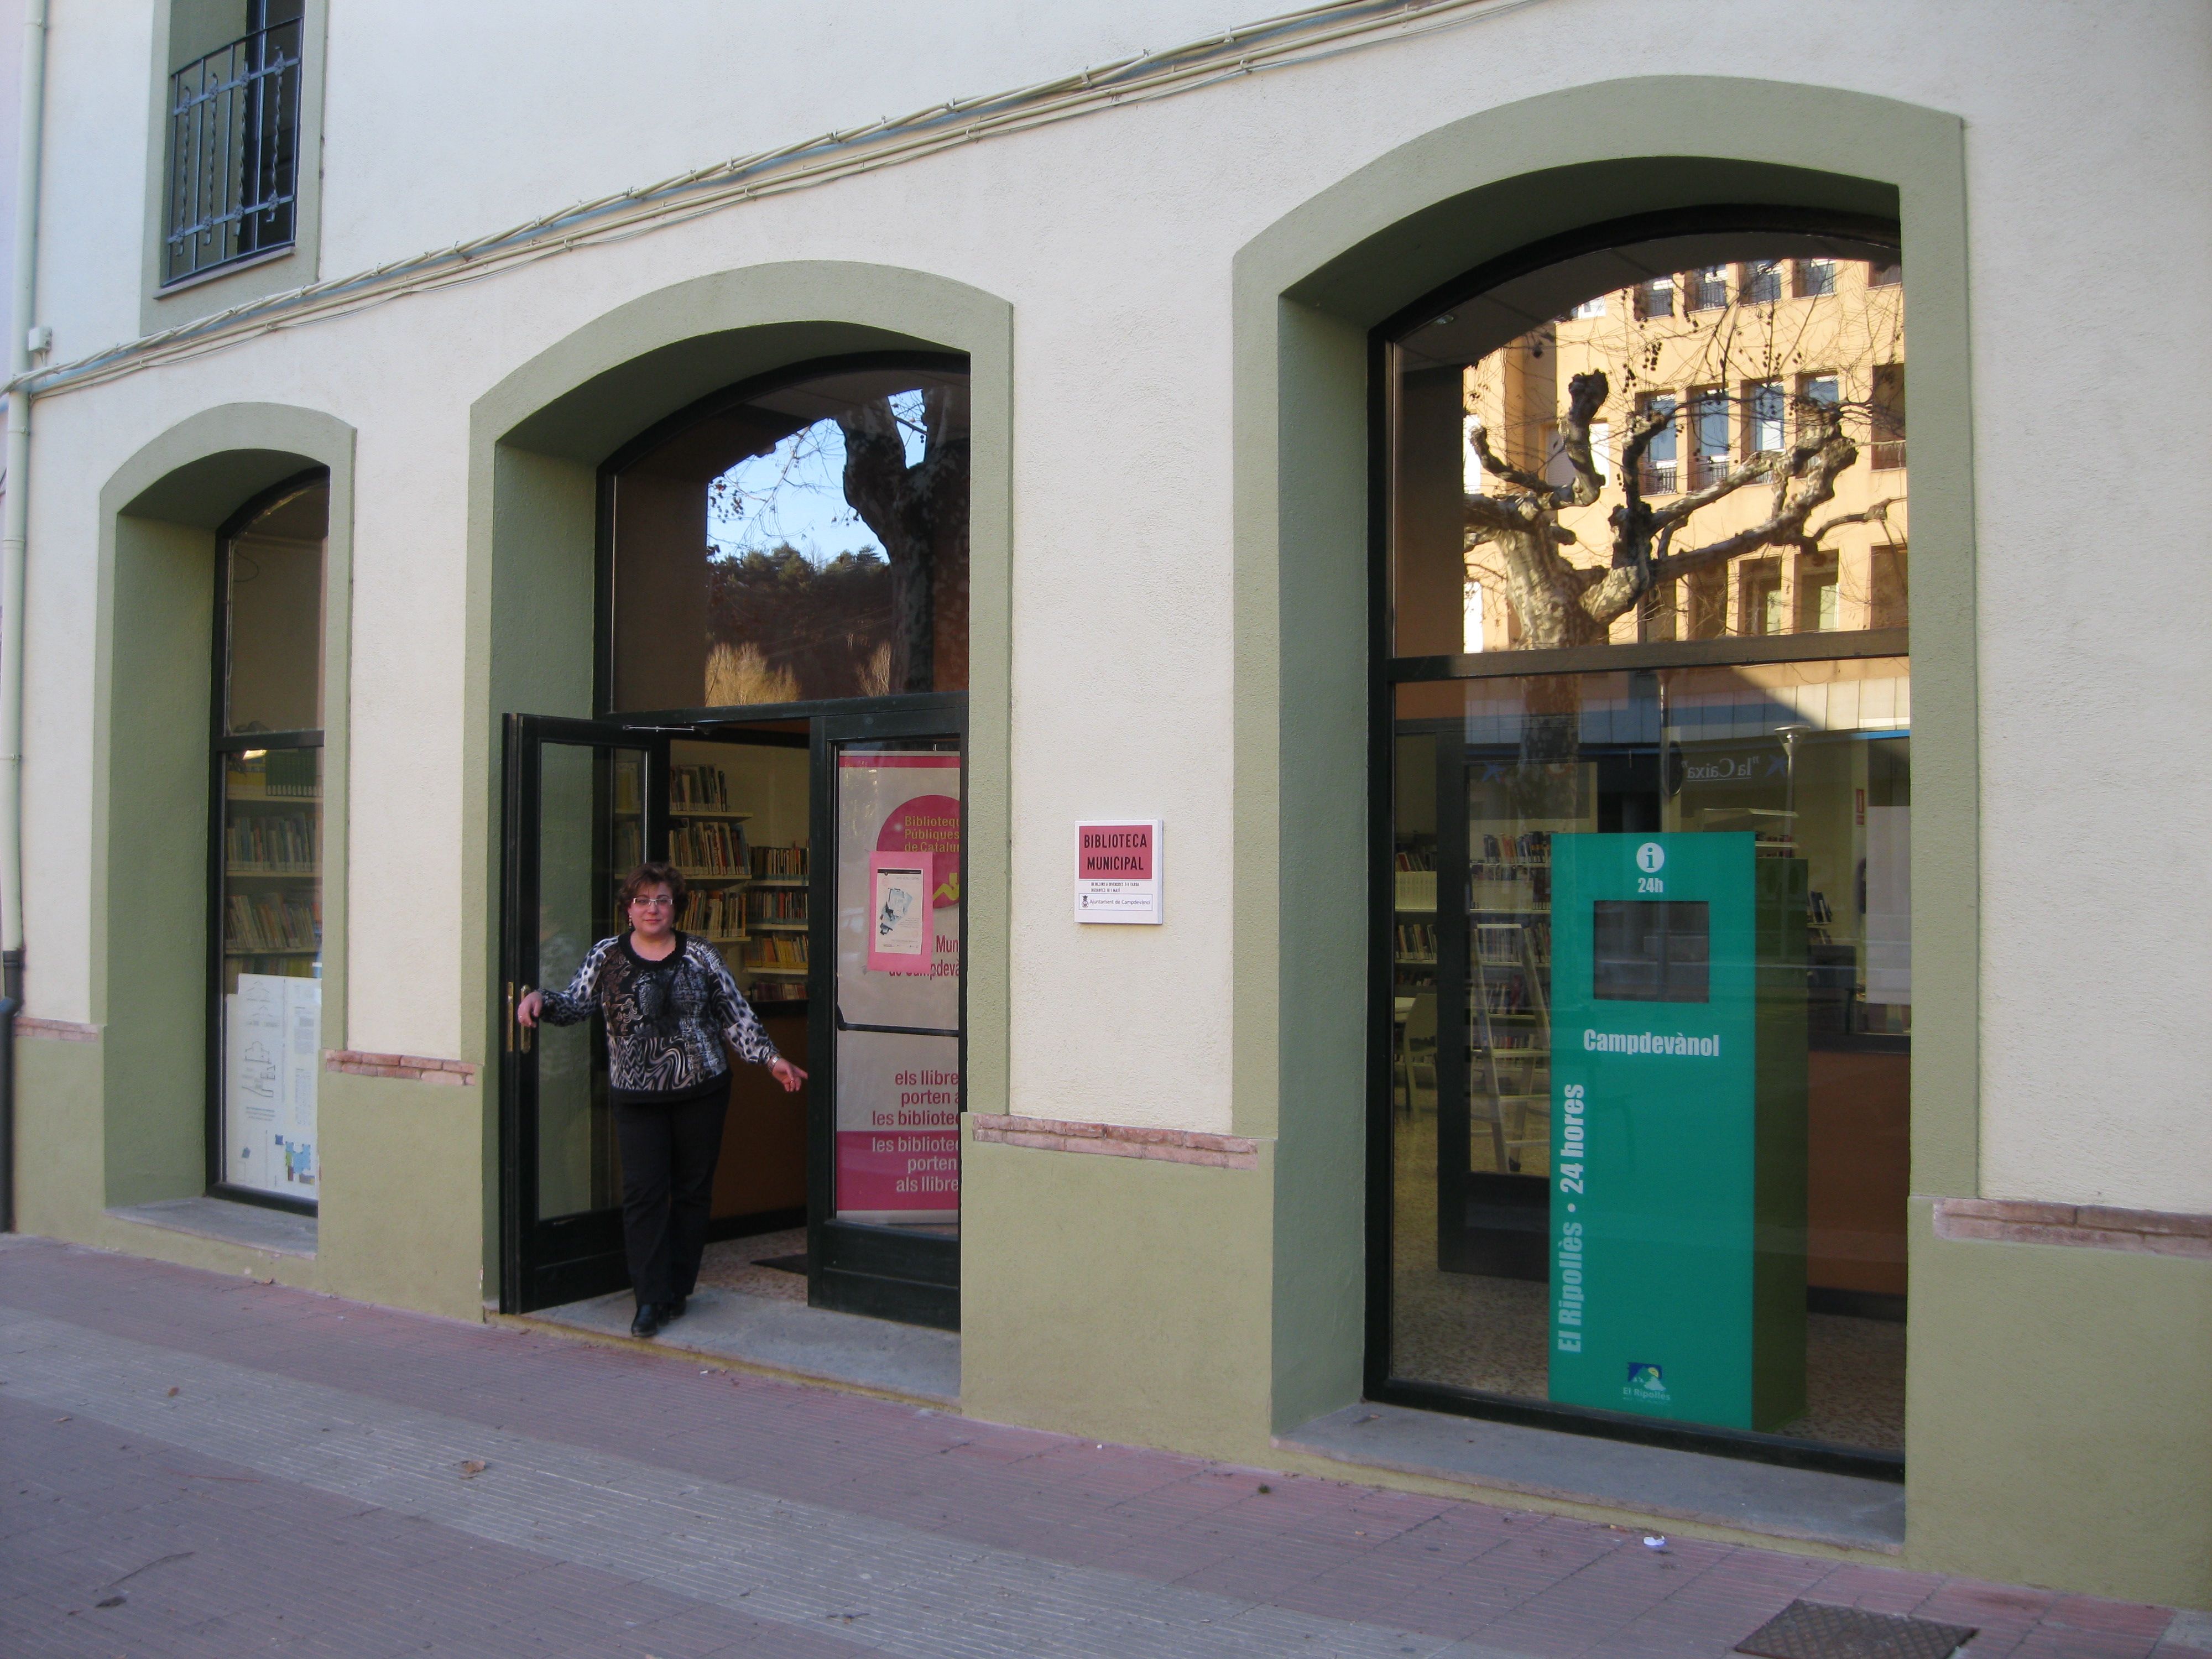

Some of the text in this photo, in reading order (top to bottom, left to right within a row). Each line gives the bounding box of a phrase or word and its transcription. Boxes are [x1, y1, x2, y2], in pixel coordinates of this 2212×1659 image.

[905, 842, 918, 852] de
[1084, 833, 1147, 848] BIBLIOTECA
[1087, 856, 1144, 871] MUNICIPAL
[1637, 878, 1664, 893] 24h
[1584, 1029, 1719, 1057] Campdevànol
[895, 1070, 959, 1085] els llibre
[901, 1089, 951, 1107] porten
[873, 1110, 894, 1125] les
[872, 1136, 894, 1152] les
[907, 1155, 957, 1173] porten
[896, 1176, 958, 1192] als llibre
[1558, 1083, 1585, 1353] El Ripollès 24 hores
